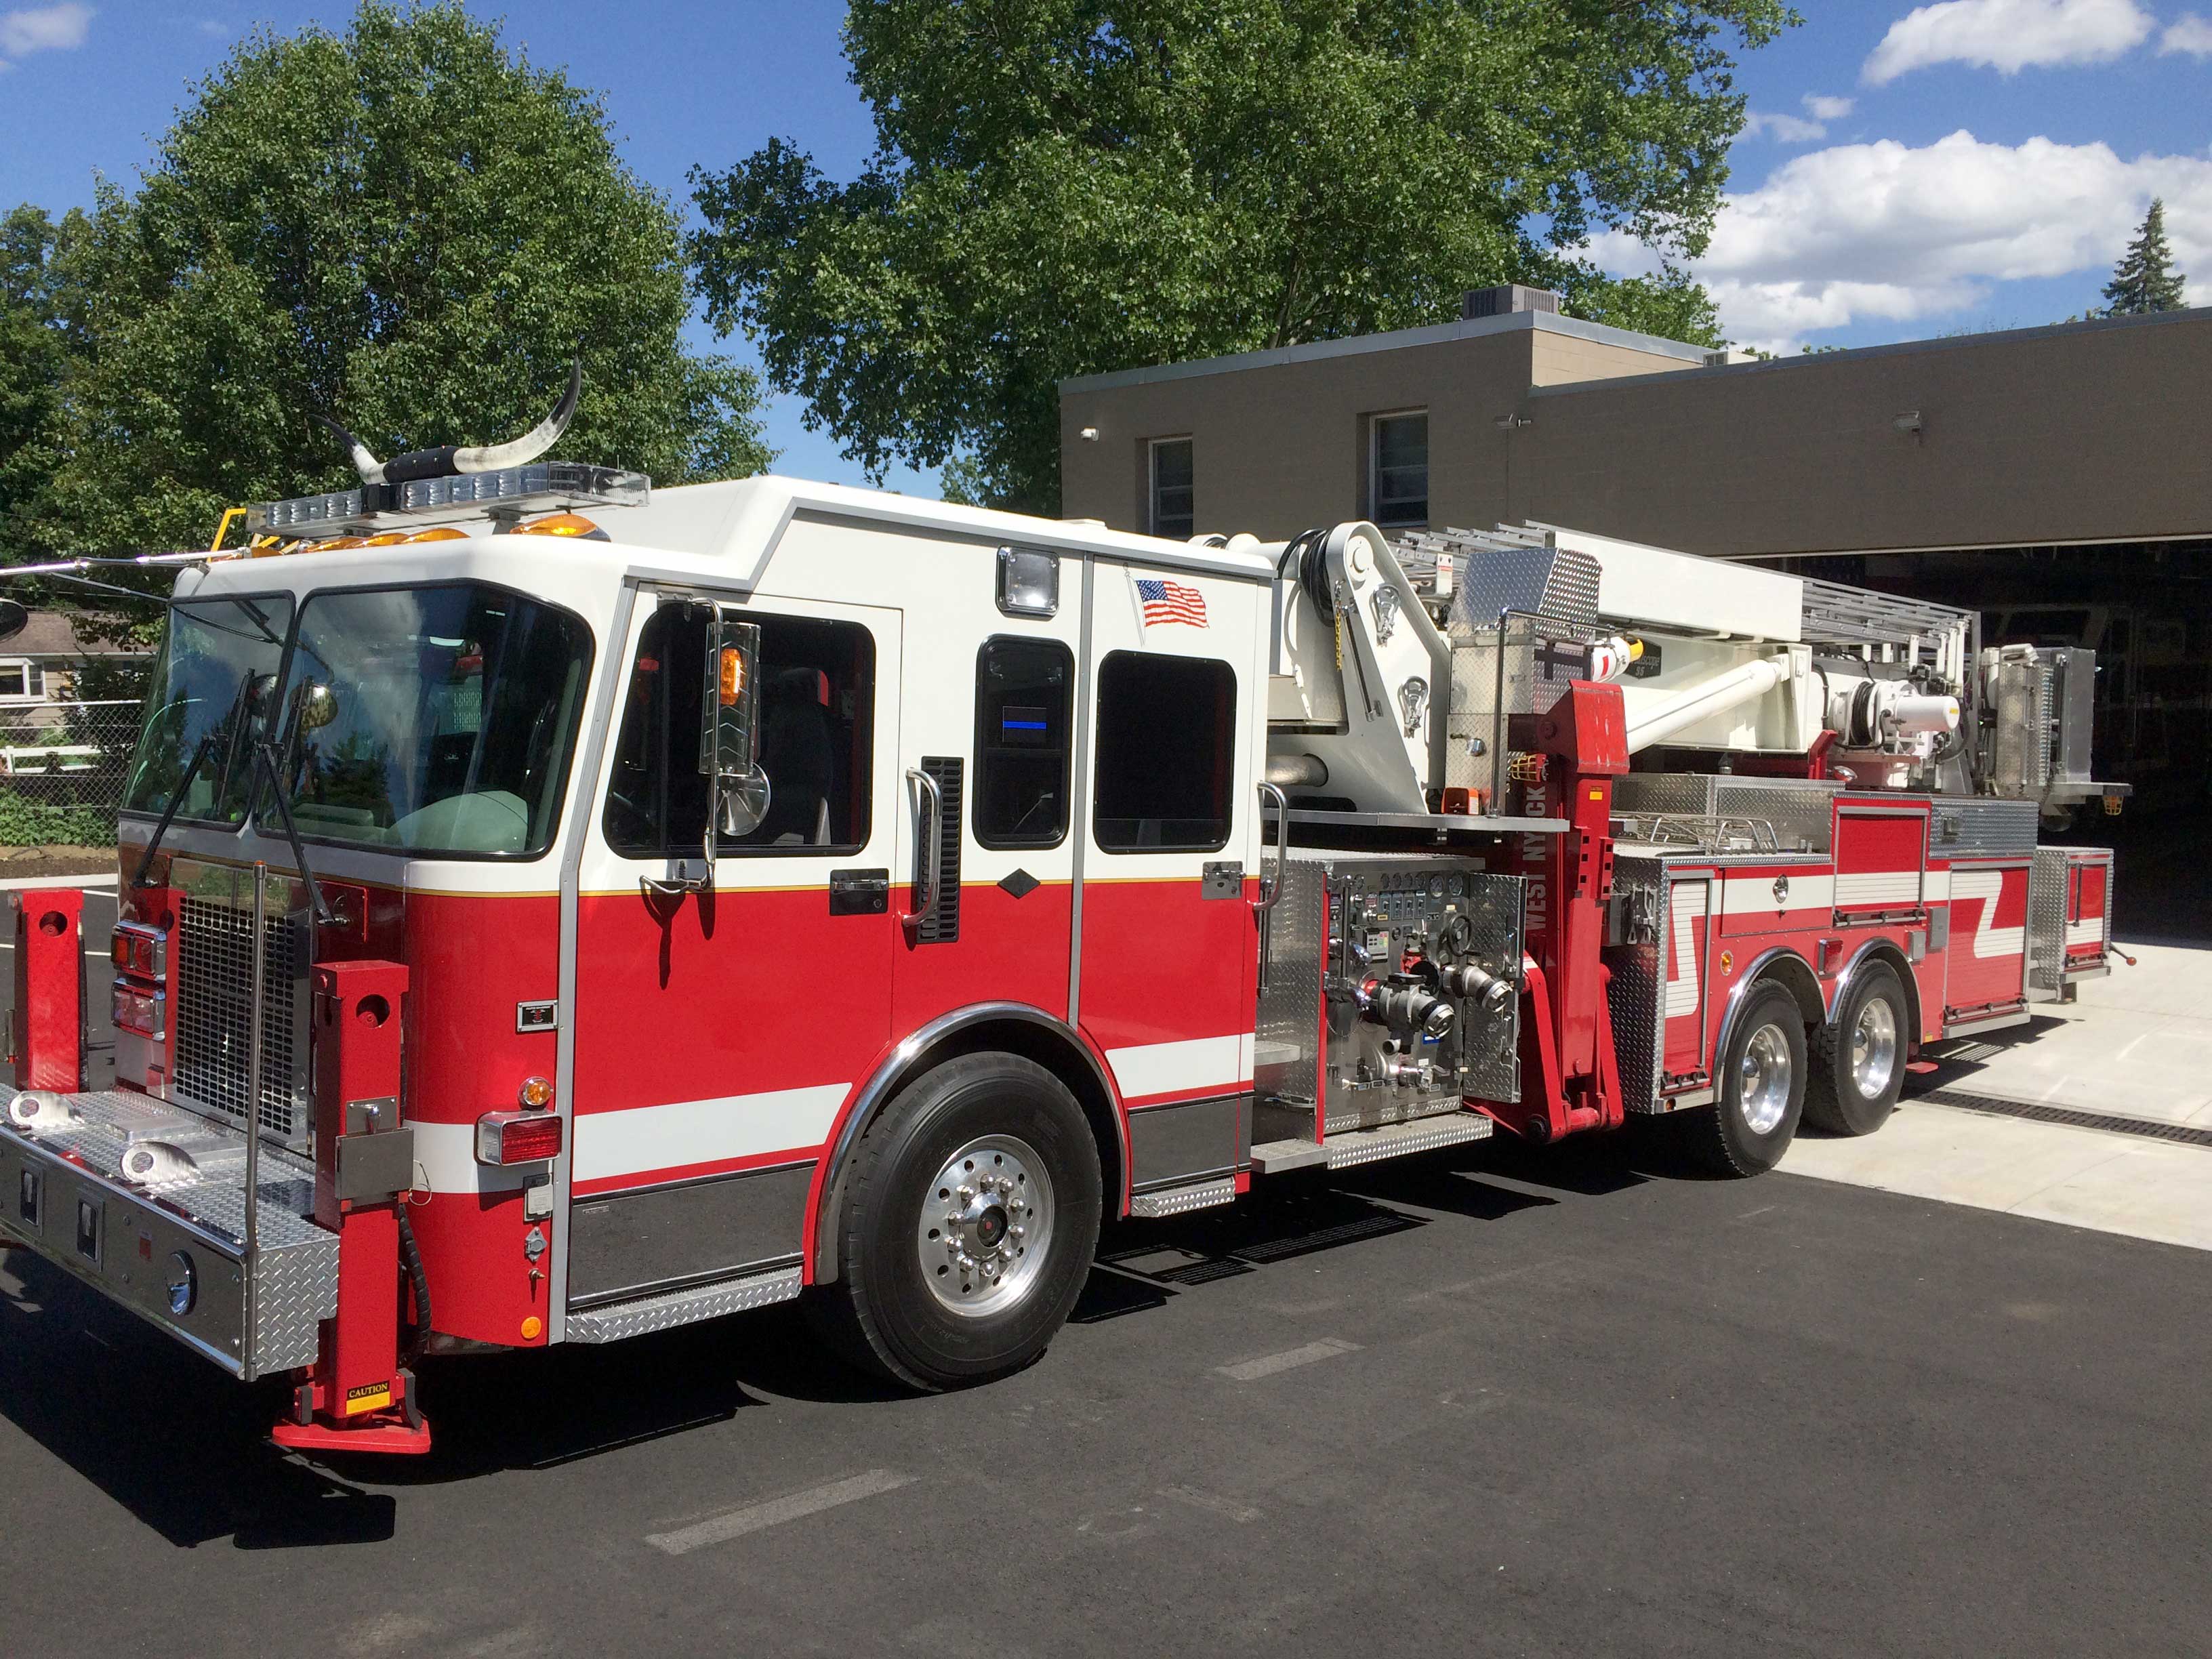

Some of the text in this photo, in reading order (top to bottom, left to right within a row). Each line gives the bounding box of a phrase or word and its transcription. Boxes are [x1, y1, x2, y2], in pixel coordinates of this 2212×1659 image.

[1521, 786, 1546, 930] WEST NYCK
[349, 1382, 388, 1398] CAUTION
